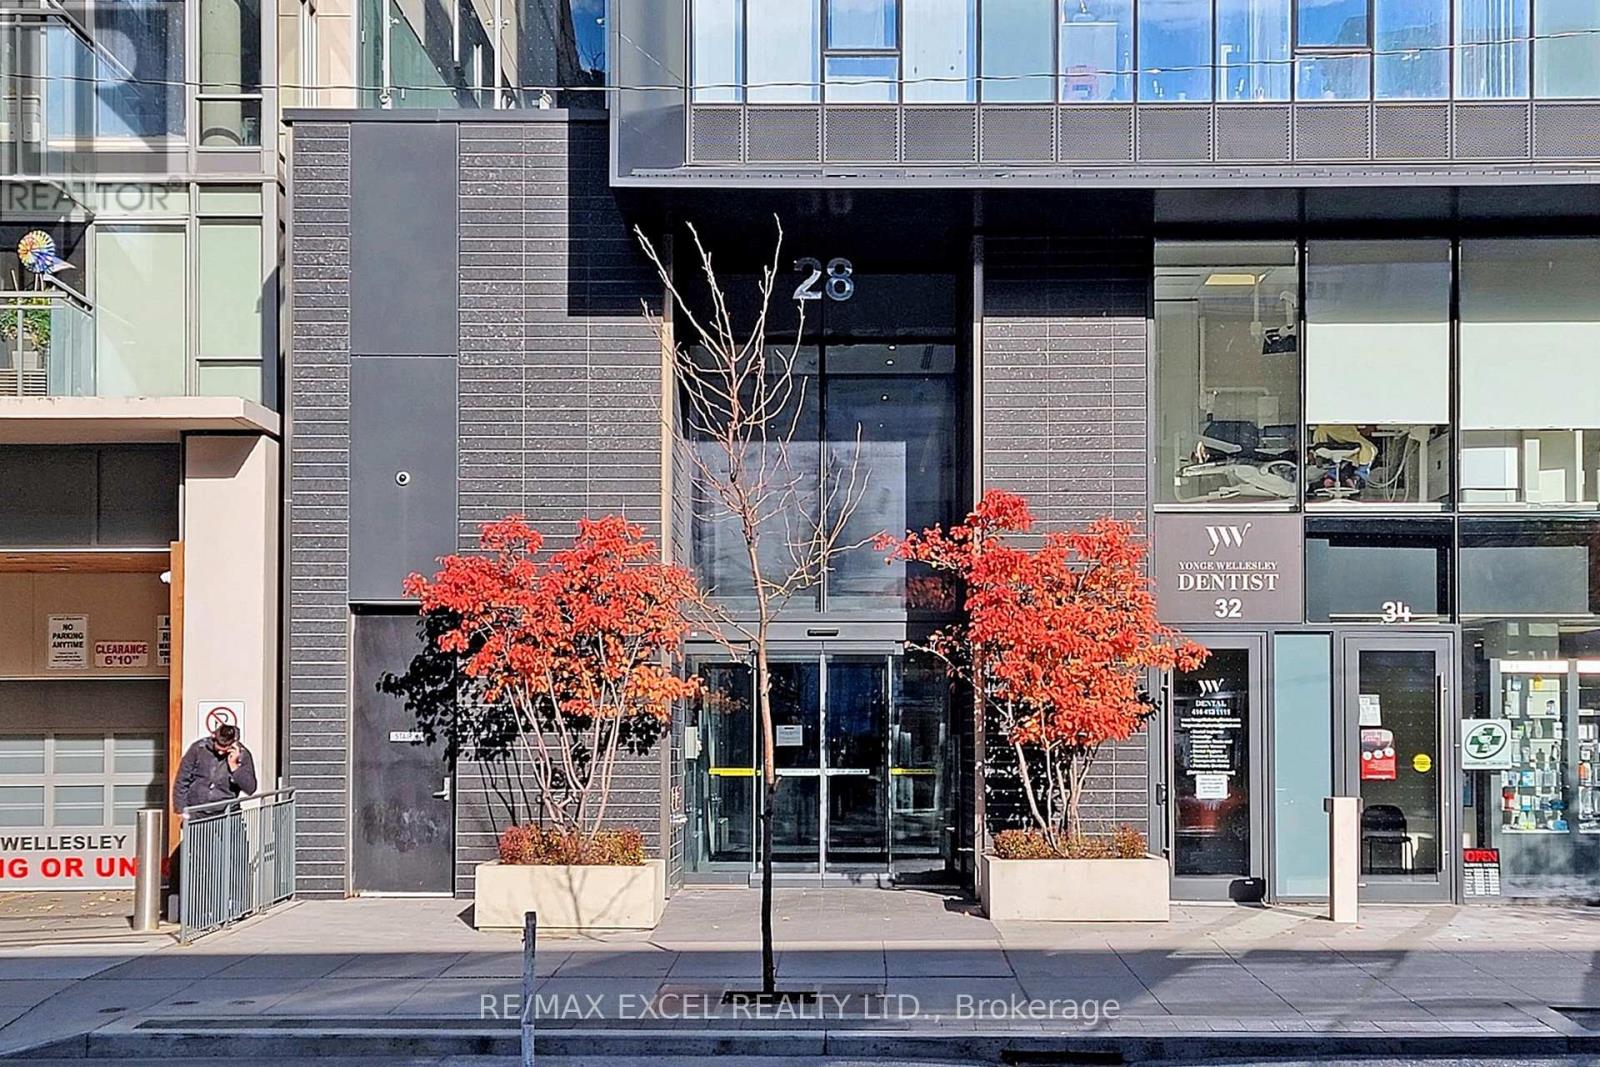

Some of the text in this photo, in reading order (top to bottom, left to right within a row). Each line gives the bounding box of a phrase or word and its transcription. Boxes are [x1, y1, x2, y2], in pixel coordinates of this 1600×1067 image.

[792, 257, 855, 301] 28
[1178, 561, 1278, 571] YONGE WELLESLEY
[1178, 574, 1279, 591] DENTIST
[1214, 598, 1242, 618] 32
[1381, 601, 1412, 622] 34
[62, 623, 74, 631] NO
[95, 644, 148, 654] CLEARANCE
[105, 655, 140, 665] 6'10"
[1, 835, 127, 851] WELLESLEY
[1465, 850, 1498, 862] OPEN
[41, 857, 84, 878] OR
[95, 857, 139, 878] UN
